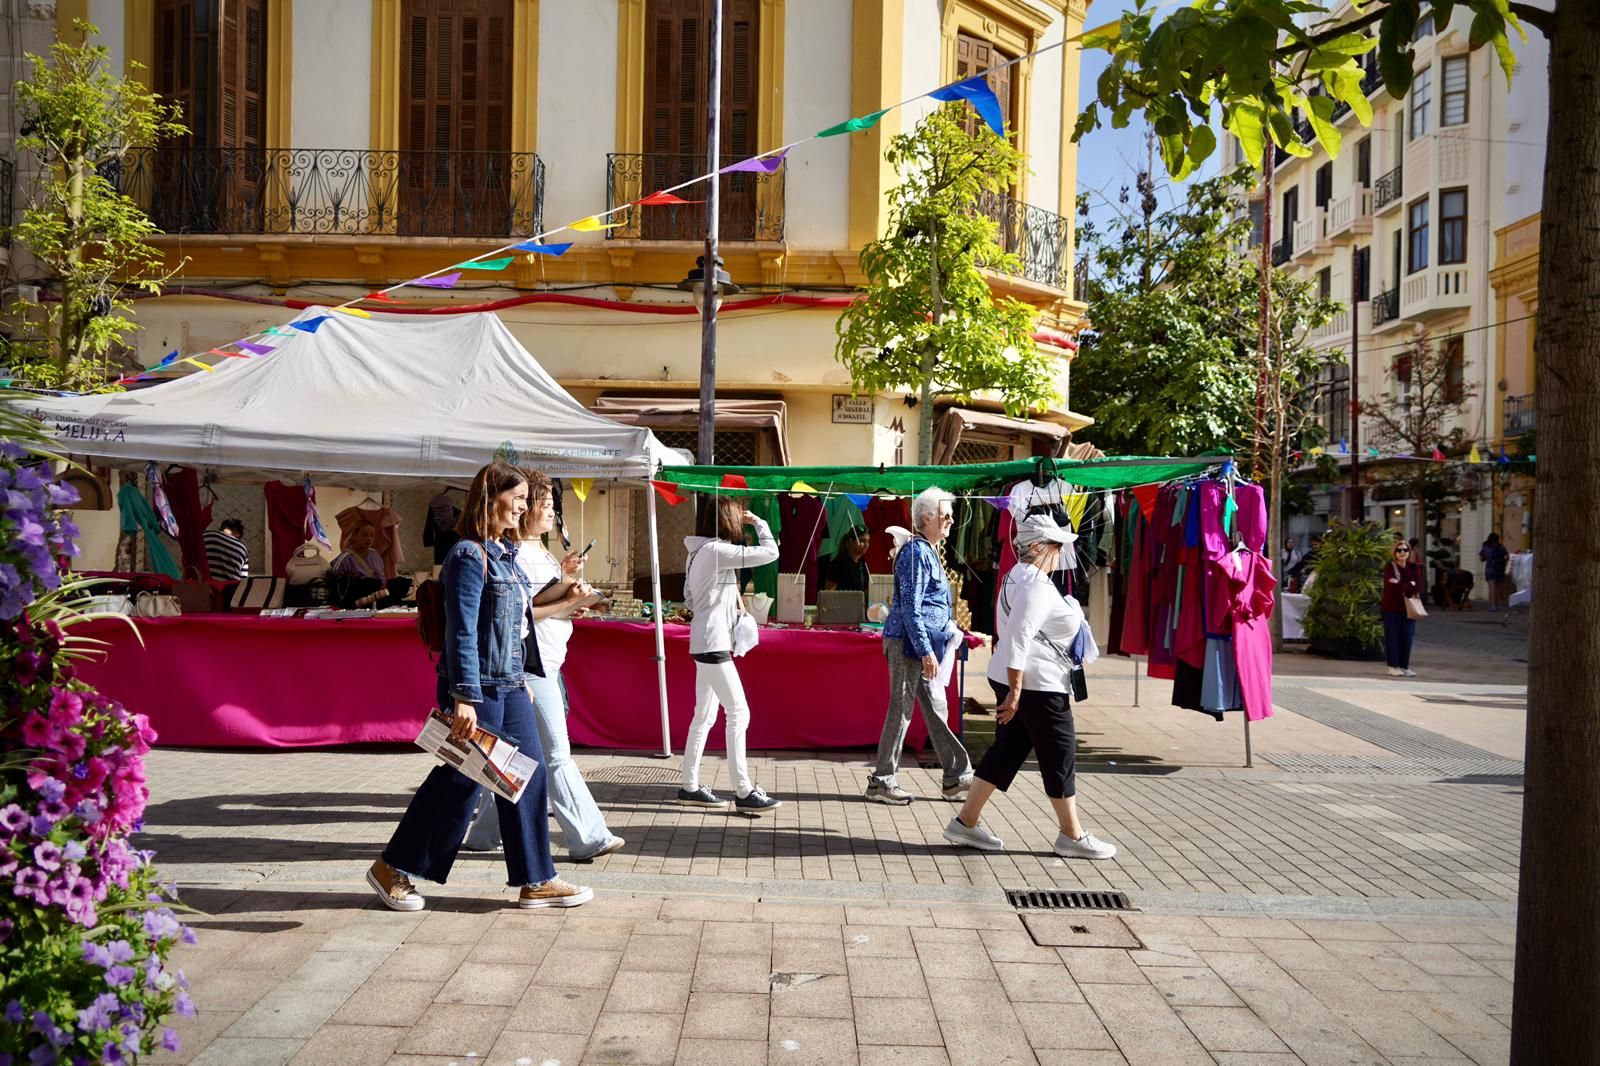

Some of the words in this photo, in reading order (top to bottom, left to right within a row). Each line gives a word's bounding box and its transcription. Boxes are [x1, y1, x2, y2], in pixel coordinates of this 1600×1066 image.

[55, 415, 82, 424] CIUDAD
[524, 448, 561, 457] MEDIO
[562, 449, 622, 457] AMBIENTE
